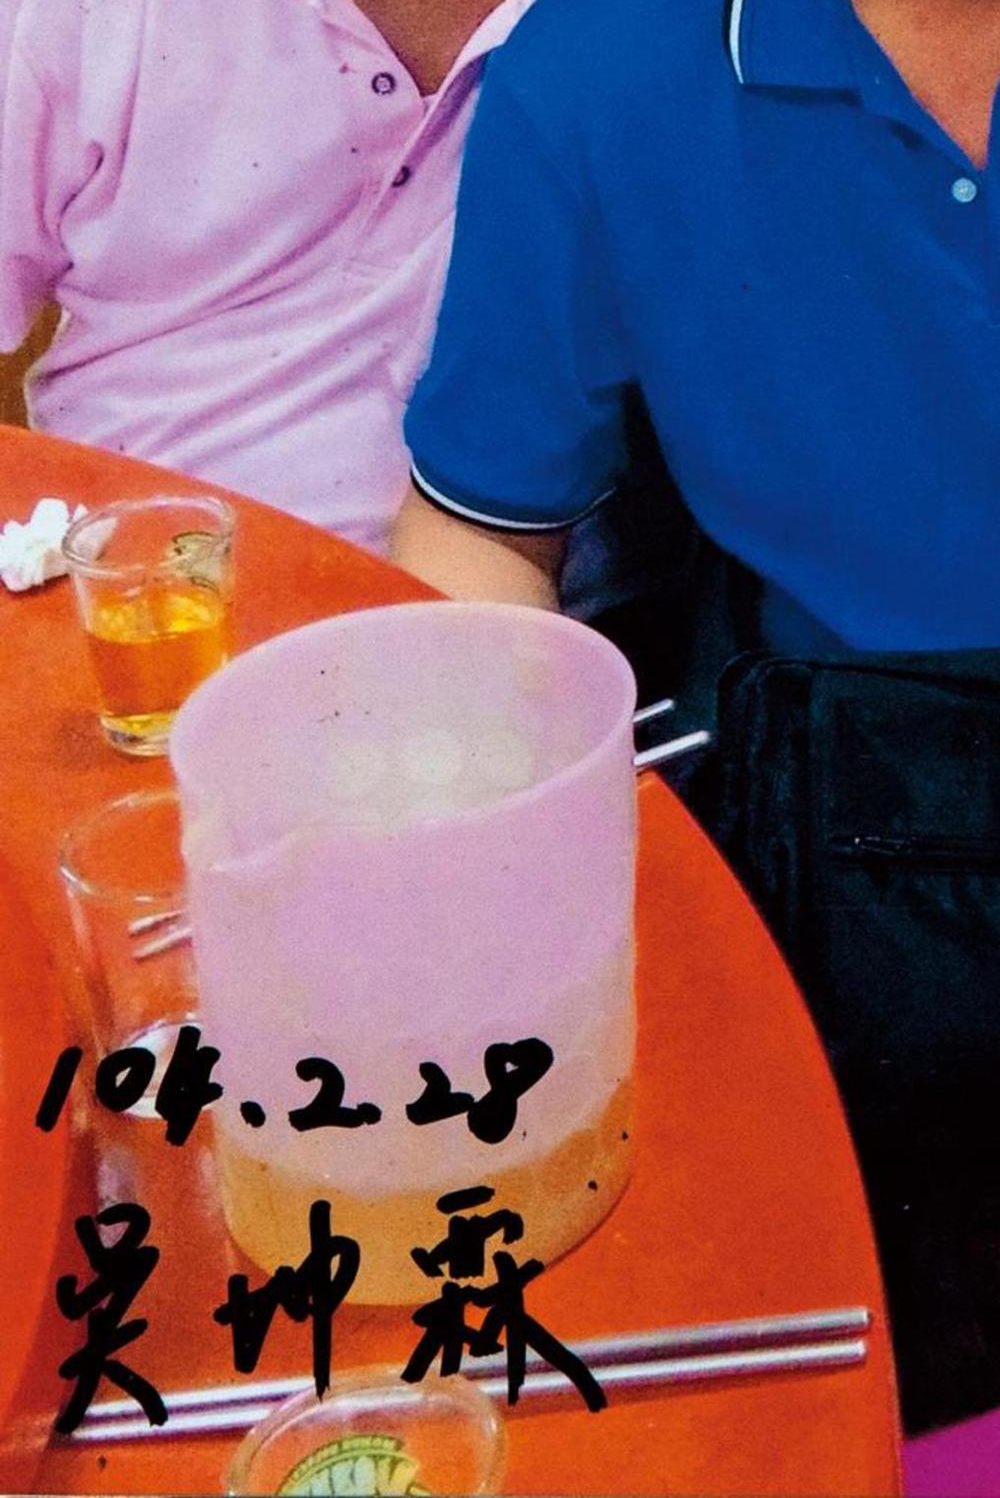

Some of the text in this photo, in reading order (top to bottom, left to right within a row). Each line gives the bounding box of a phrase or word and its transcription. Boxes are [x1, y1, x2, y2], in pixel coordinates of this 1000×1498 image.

[35, 1026, 555, 1145] 104.2.28
[54, 1186, 607, 1434] 吳坤霖
